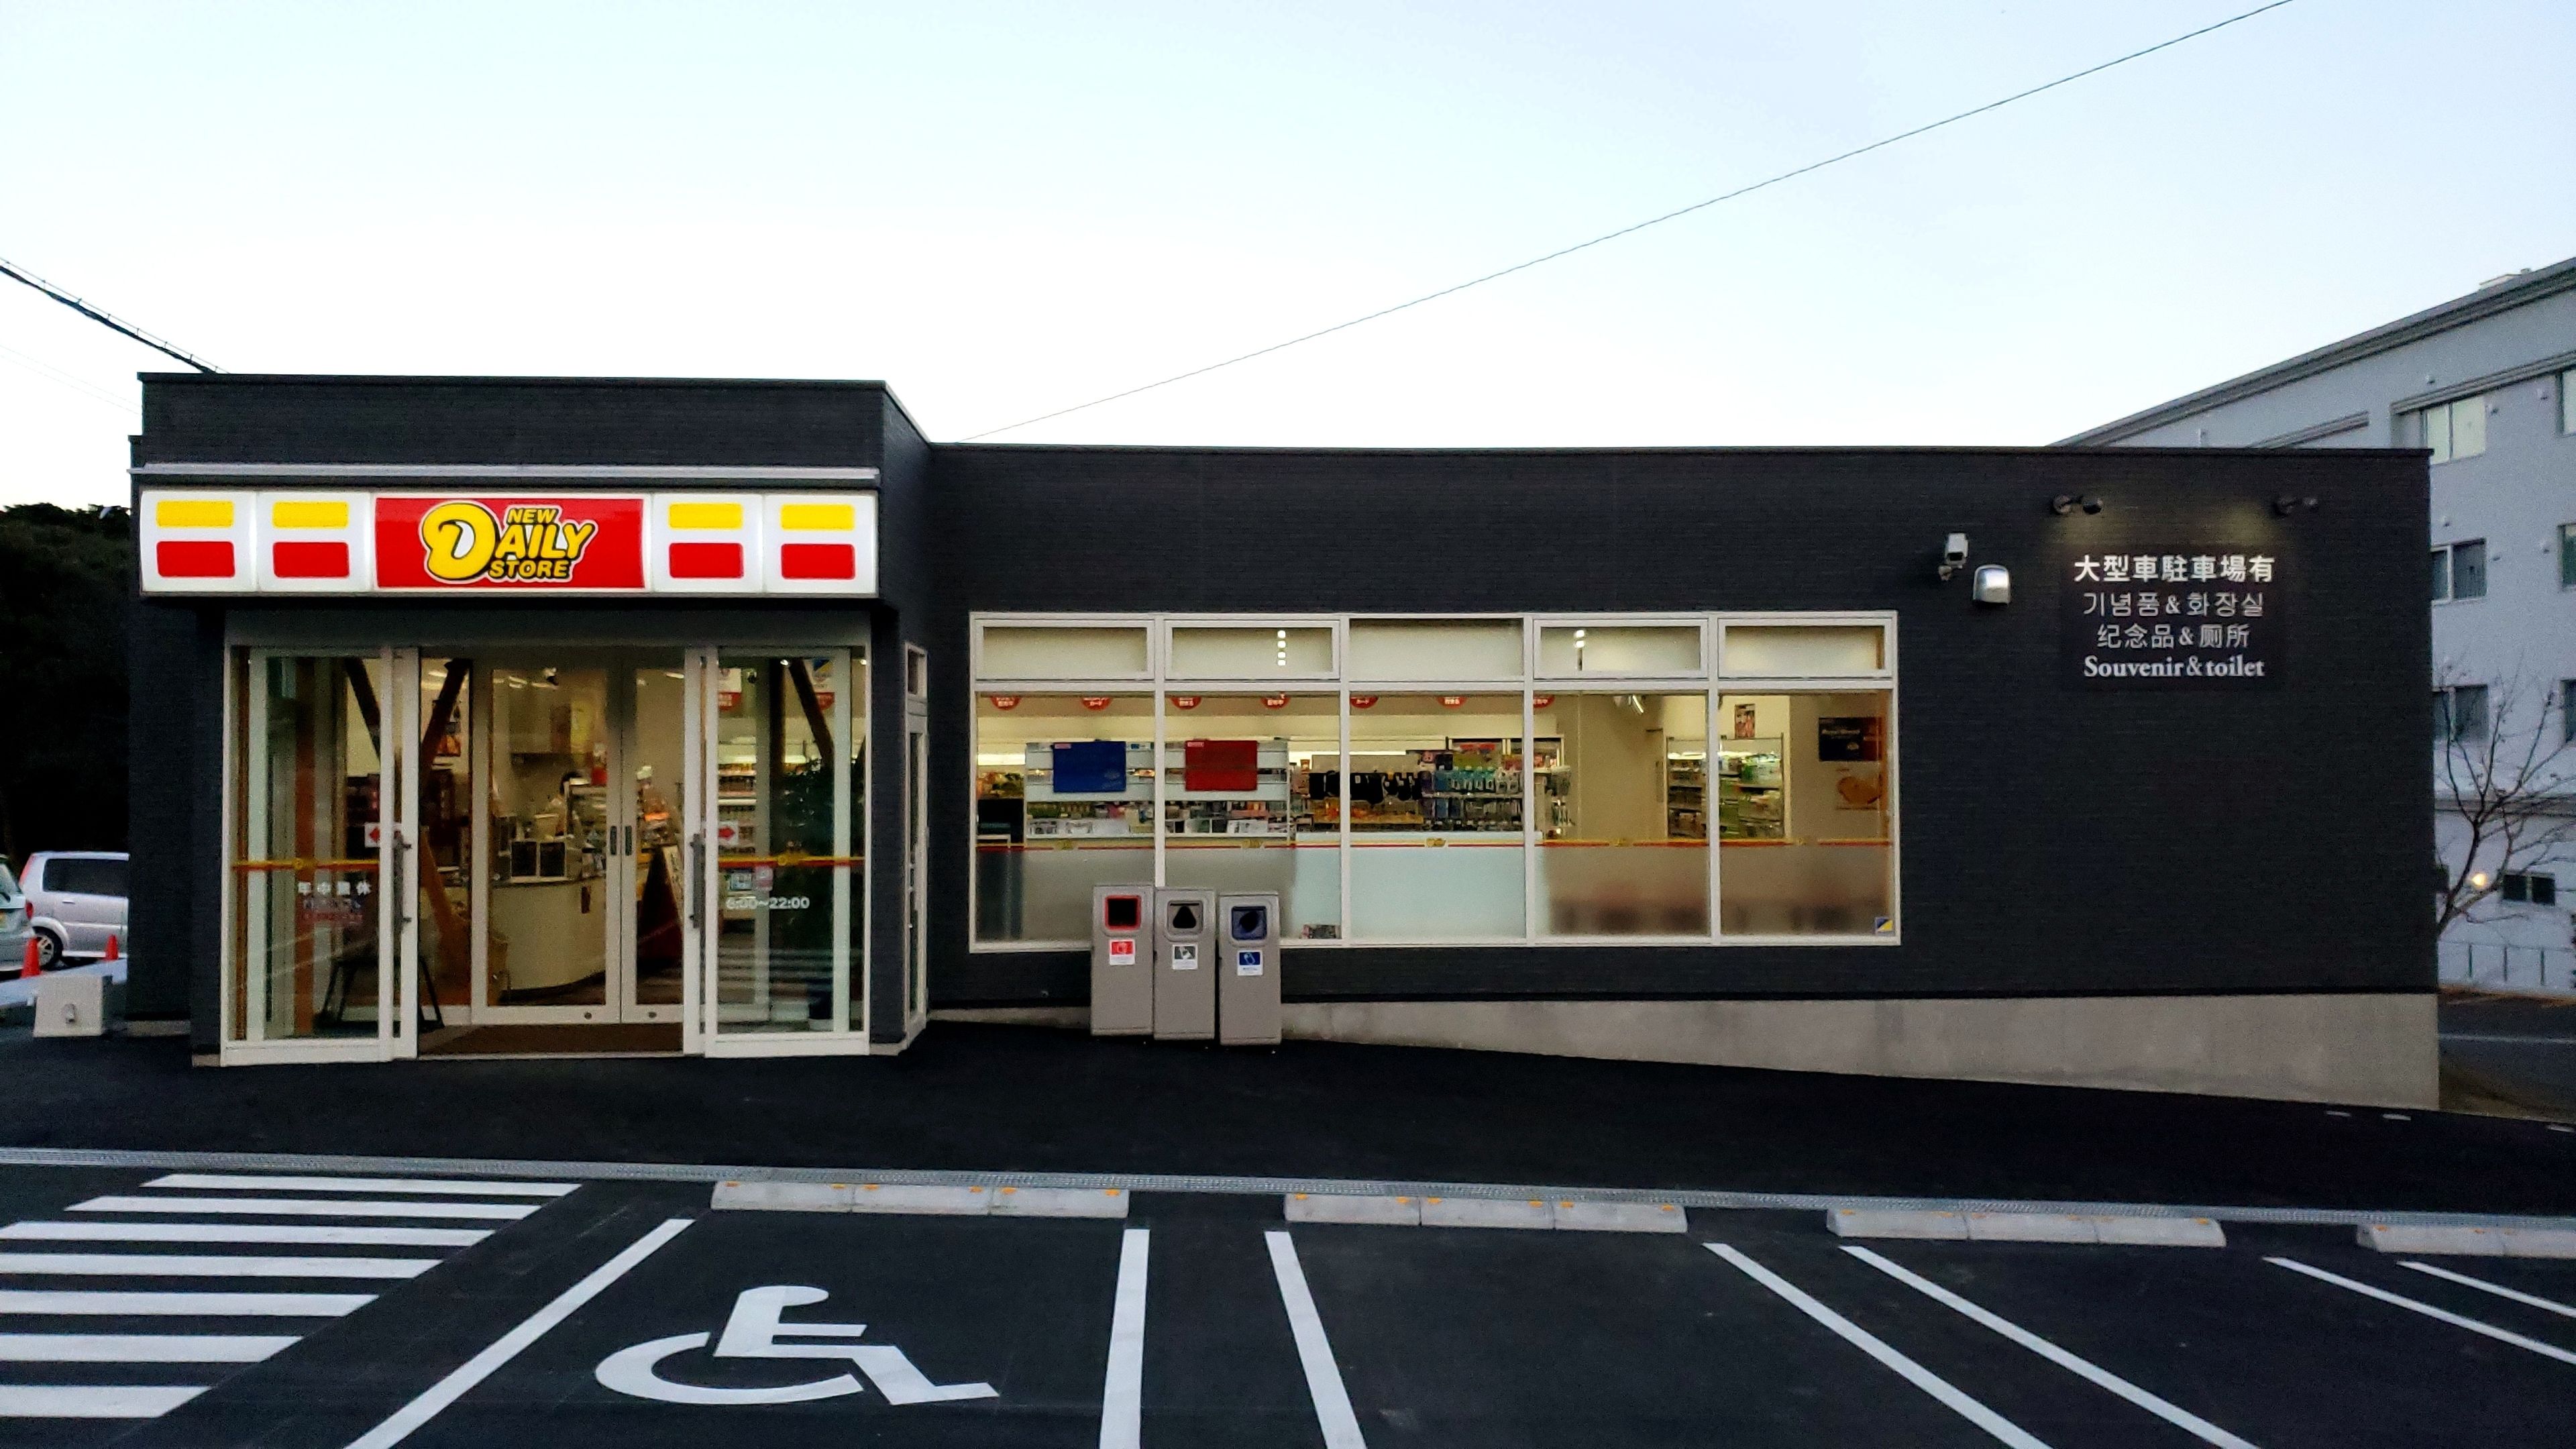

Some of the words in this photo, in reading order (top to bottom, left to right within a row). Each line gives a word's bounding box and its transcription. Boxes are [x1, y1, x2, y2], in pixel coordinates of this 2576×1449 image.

[507, 508, 558, 523] NEW
[421, 502, 595, 581] DAILY
[488, 559, 570, 578] STORE
[2074, 555, 2275, 583] 大型車駐車場有
